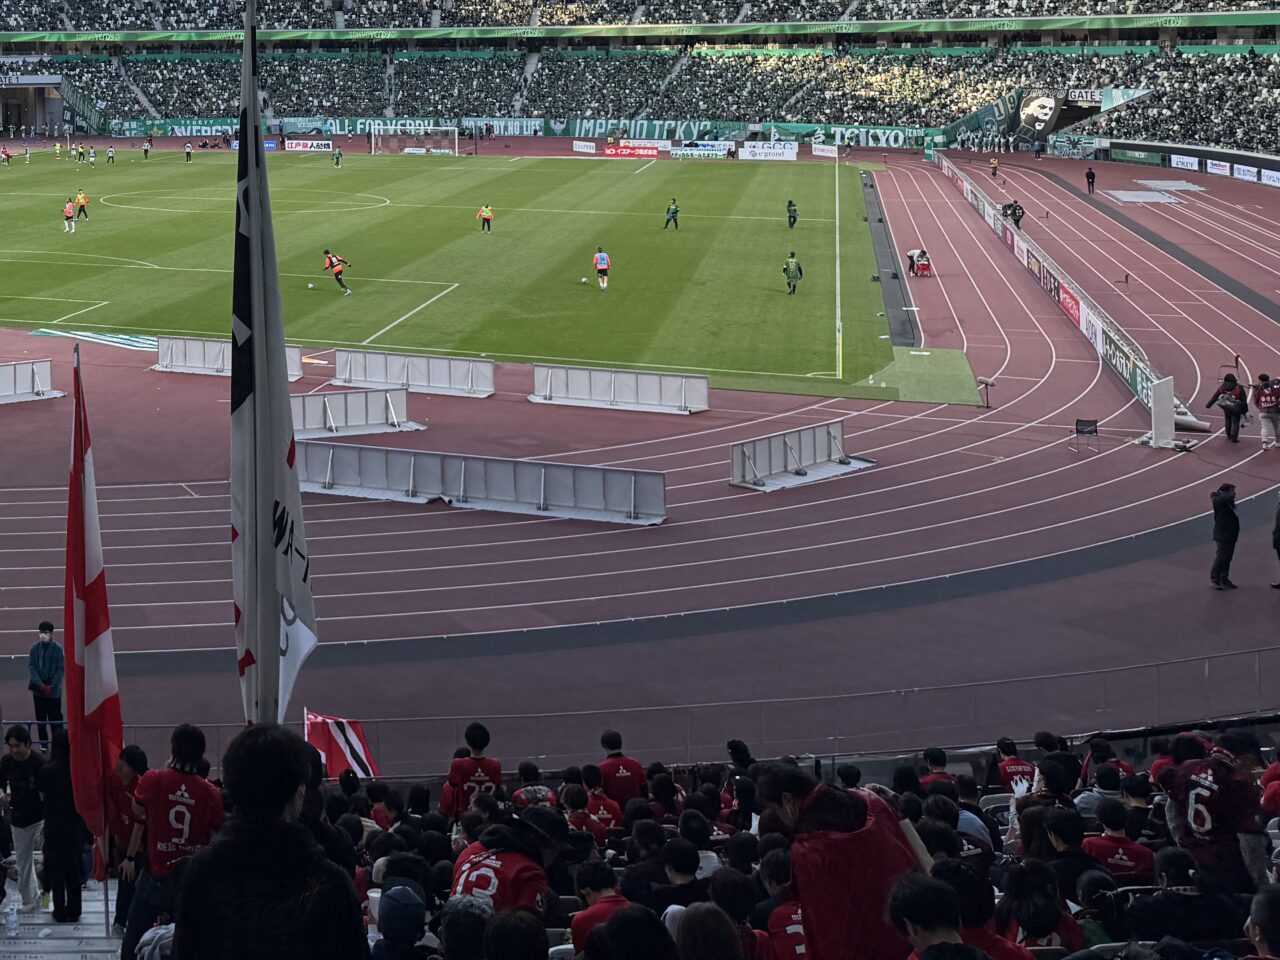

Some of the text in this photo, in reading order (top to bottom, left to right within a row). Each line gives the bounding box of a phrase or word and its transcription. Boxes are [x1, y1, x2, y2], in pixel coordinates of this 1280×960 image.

[16, 76, 20, 84] 1
[1070, 90, 1096, 101] GATE
[356, 119, 383, 135] FOR
[831, 127, 904, 147] TOKYO
[1188, 787, 1212, 833] 6
[169, 804, 191, 844] 9
